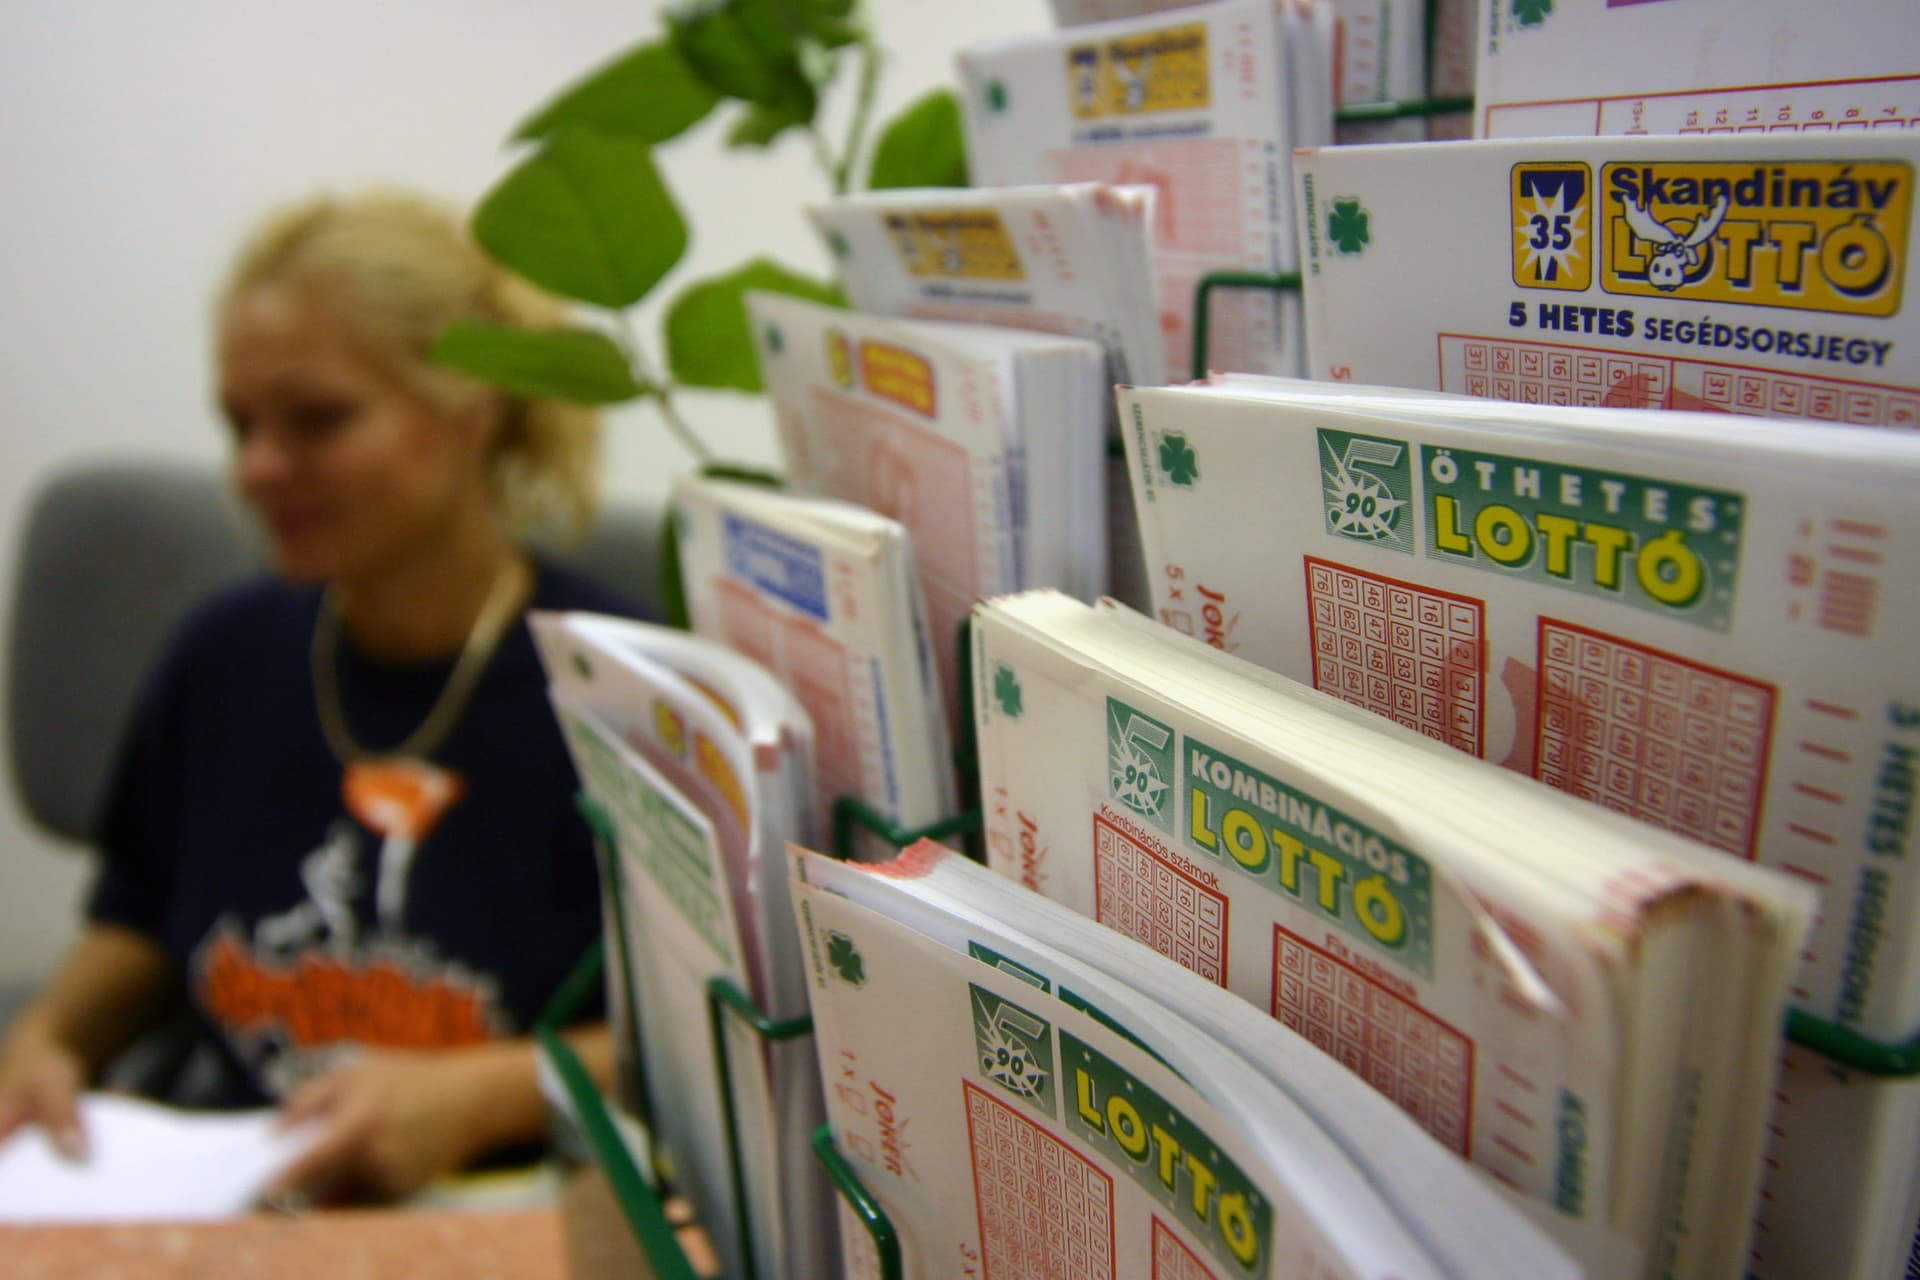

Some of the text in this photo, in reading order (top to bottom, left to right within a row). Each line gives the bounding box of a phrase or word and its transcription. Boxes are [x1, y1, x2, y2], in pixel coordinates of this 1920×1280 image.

[1686, 110, 1697, 126] 13
[1716, 109, 1728, 124] 12
[1746, 108, 1758, 121] 11
[1777, 106, 1790, 121] 10
[1811, 110, 1824, 119] 9
[1882, 107, 1896, 115] 7
[1609, 166, 1898, 211] Skandináv
[1529, 214, 1572, 250] 35
[1508, 301, 1892, 366] 5 HETES SEGÉDSORSJEGY
[1469, 349, 1483, 367] 31
[1496, 351, 1510, 370] 26
[1524, 354, 1538, 372] 21
[1552, 358, 1566, 376] 16
[1583, 361, 1596, 379] 11
[1612, 368, 1626, 380] 6
[1646, 375, 1658, 383] 1
[1709, 377, 1725, 396] 31
[1744, 382, 1760, 403] 26
[1779, 387, 1795, 407] 21
[1431, 449, 1716, 532] ÖTHETES
[1344, 493, 1376, 518] 90
[1434, 495, 1704, 606] LOTTÓ
[1165, 564, 1184, 580] 5
[1197, 585, 1226, 649] JOK
[1317, 572, 1335, 682] 76 77 78 79
[1342, 579, 1359, 689] 61 62 63 64
[1368, 587, 1385, 700] 46 47 48 49
[1394, 594, 1412, 710] 31 32 33 34
[1423, 604, 1440, 741] 16 17 18 19 2
[1455, 616, 1470, 724] 1 2 3 4
[1125, 764, 1148, 794] 90
[1190, 749, 1411, 885] KOMBINÁCIÓS
[1101, 803, 1220, 890] Kombinációs számok
[1120, 843, 1130, 862] 61
[1190, 788, 1407, 949] LOTTÓ
[1139, 858, 1150, 939] 46 47 48
[1158, 871, 1169, 954] 31 32 33
[1180, 889, 1191, 969] 16 17 18
[1202, 907, 1216, 981] 1 2 3
[1284, 946, 1299, 1003] 76 77
[841, 1050, 857, 1061] 1
[996, 1046, 1025, 1077] 90
[869, 1080, 903, 1178] JOKER
[997, 1112, 1008, 1128] 61
[1019, 1124, 1032, 1147] 46
[1043, 1138, 1055, 1160] 31
[1023, 1154, 1035, 1175] 47
[1068, 1160, 1079, 1179] 16
[1075, 1068, 1258, 1272] LOTTÓ
[1046, 1170, 1057, 1192] 32
[1092, 1183, 1102, 1192] 1
[1070, 1187, 1080, 1209] 17
[1093, 1209, 1103, 1223] 2
[1071, 1220, 1082, 1238] 18
[1094, 1239, 1104, 1253] 3
